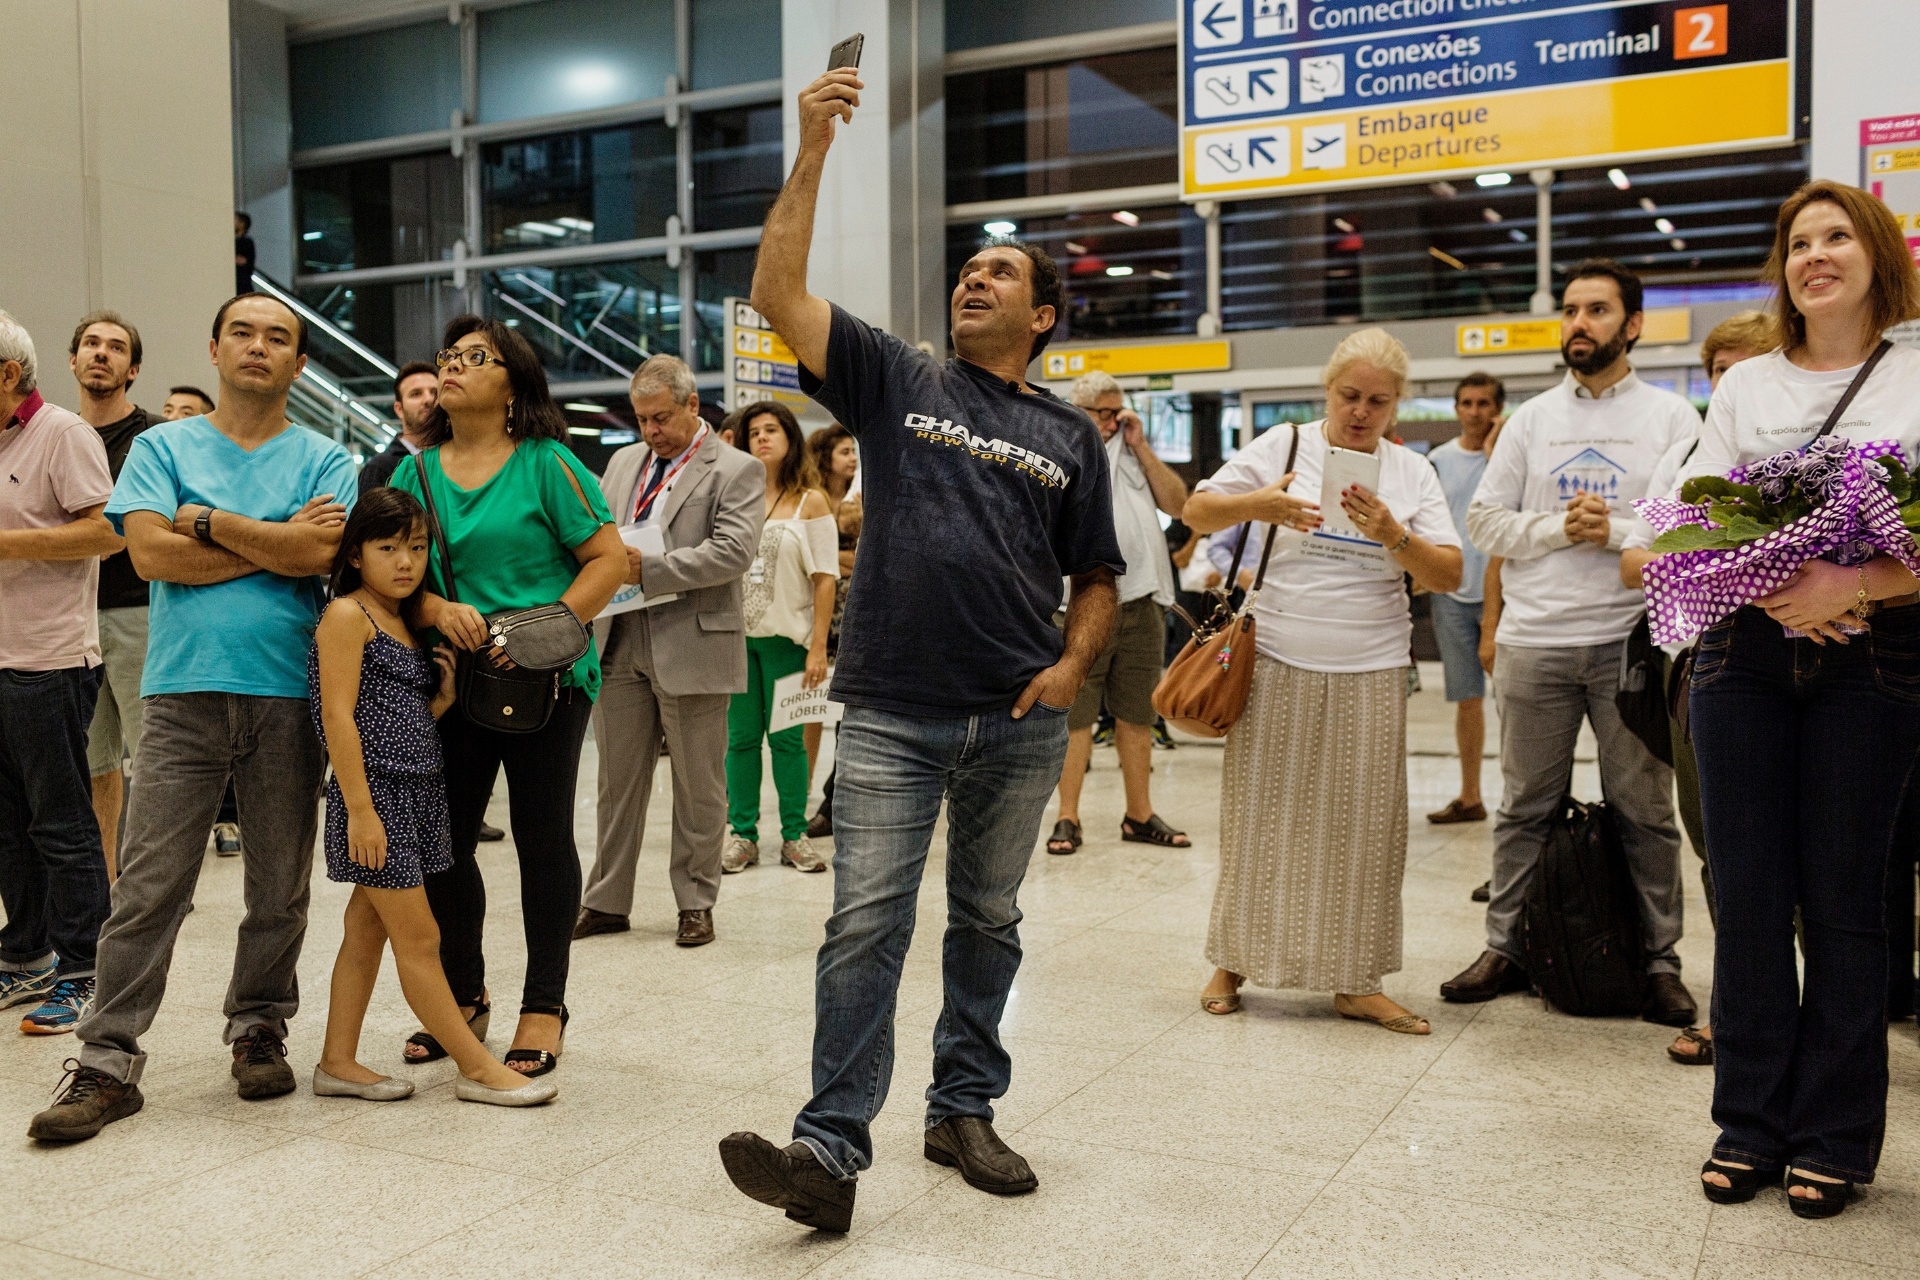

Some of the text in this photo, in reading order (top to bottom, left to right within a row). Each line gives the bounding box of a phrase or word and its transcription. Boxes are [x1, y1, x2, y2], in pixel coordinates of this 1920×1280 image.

[1308, 0, 1454, 31] Connection
[1355, 12, 1716, 69] Conexões Terminal 2
[1355, 60, 1518, 98] Connections
[1358, 107, 1489, 136] Embarque
[1358, 134, 1501, 168] Departures
[1771, 426, 1799, 436] apóio
[1835, 419, 1871, 431] Família
[916, 430, 1056, 488] HOW YOU PLAY
[780, 688, 831, 708] CHRISTIA
[789, 704, 827, 721] LÖBER
